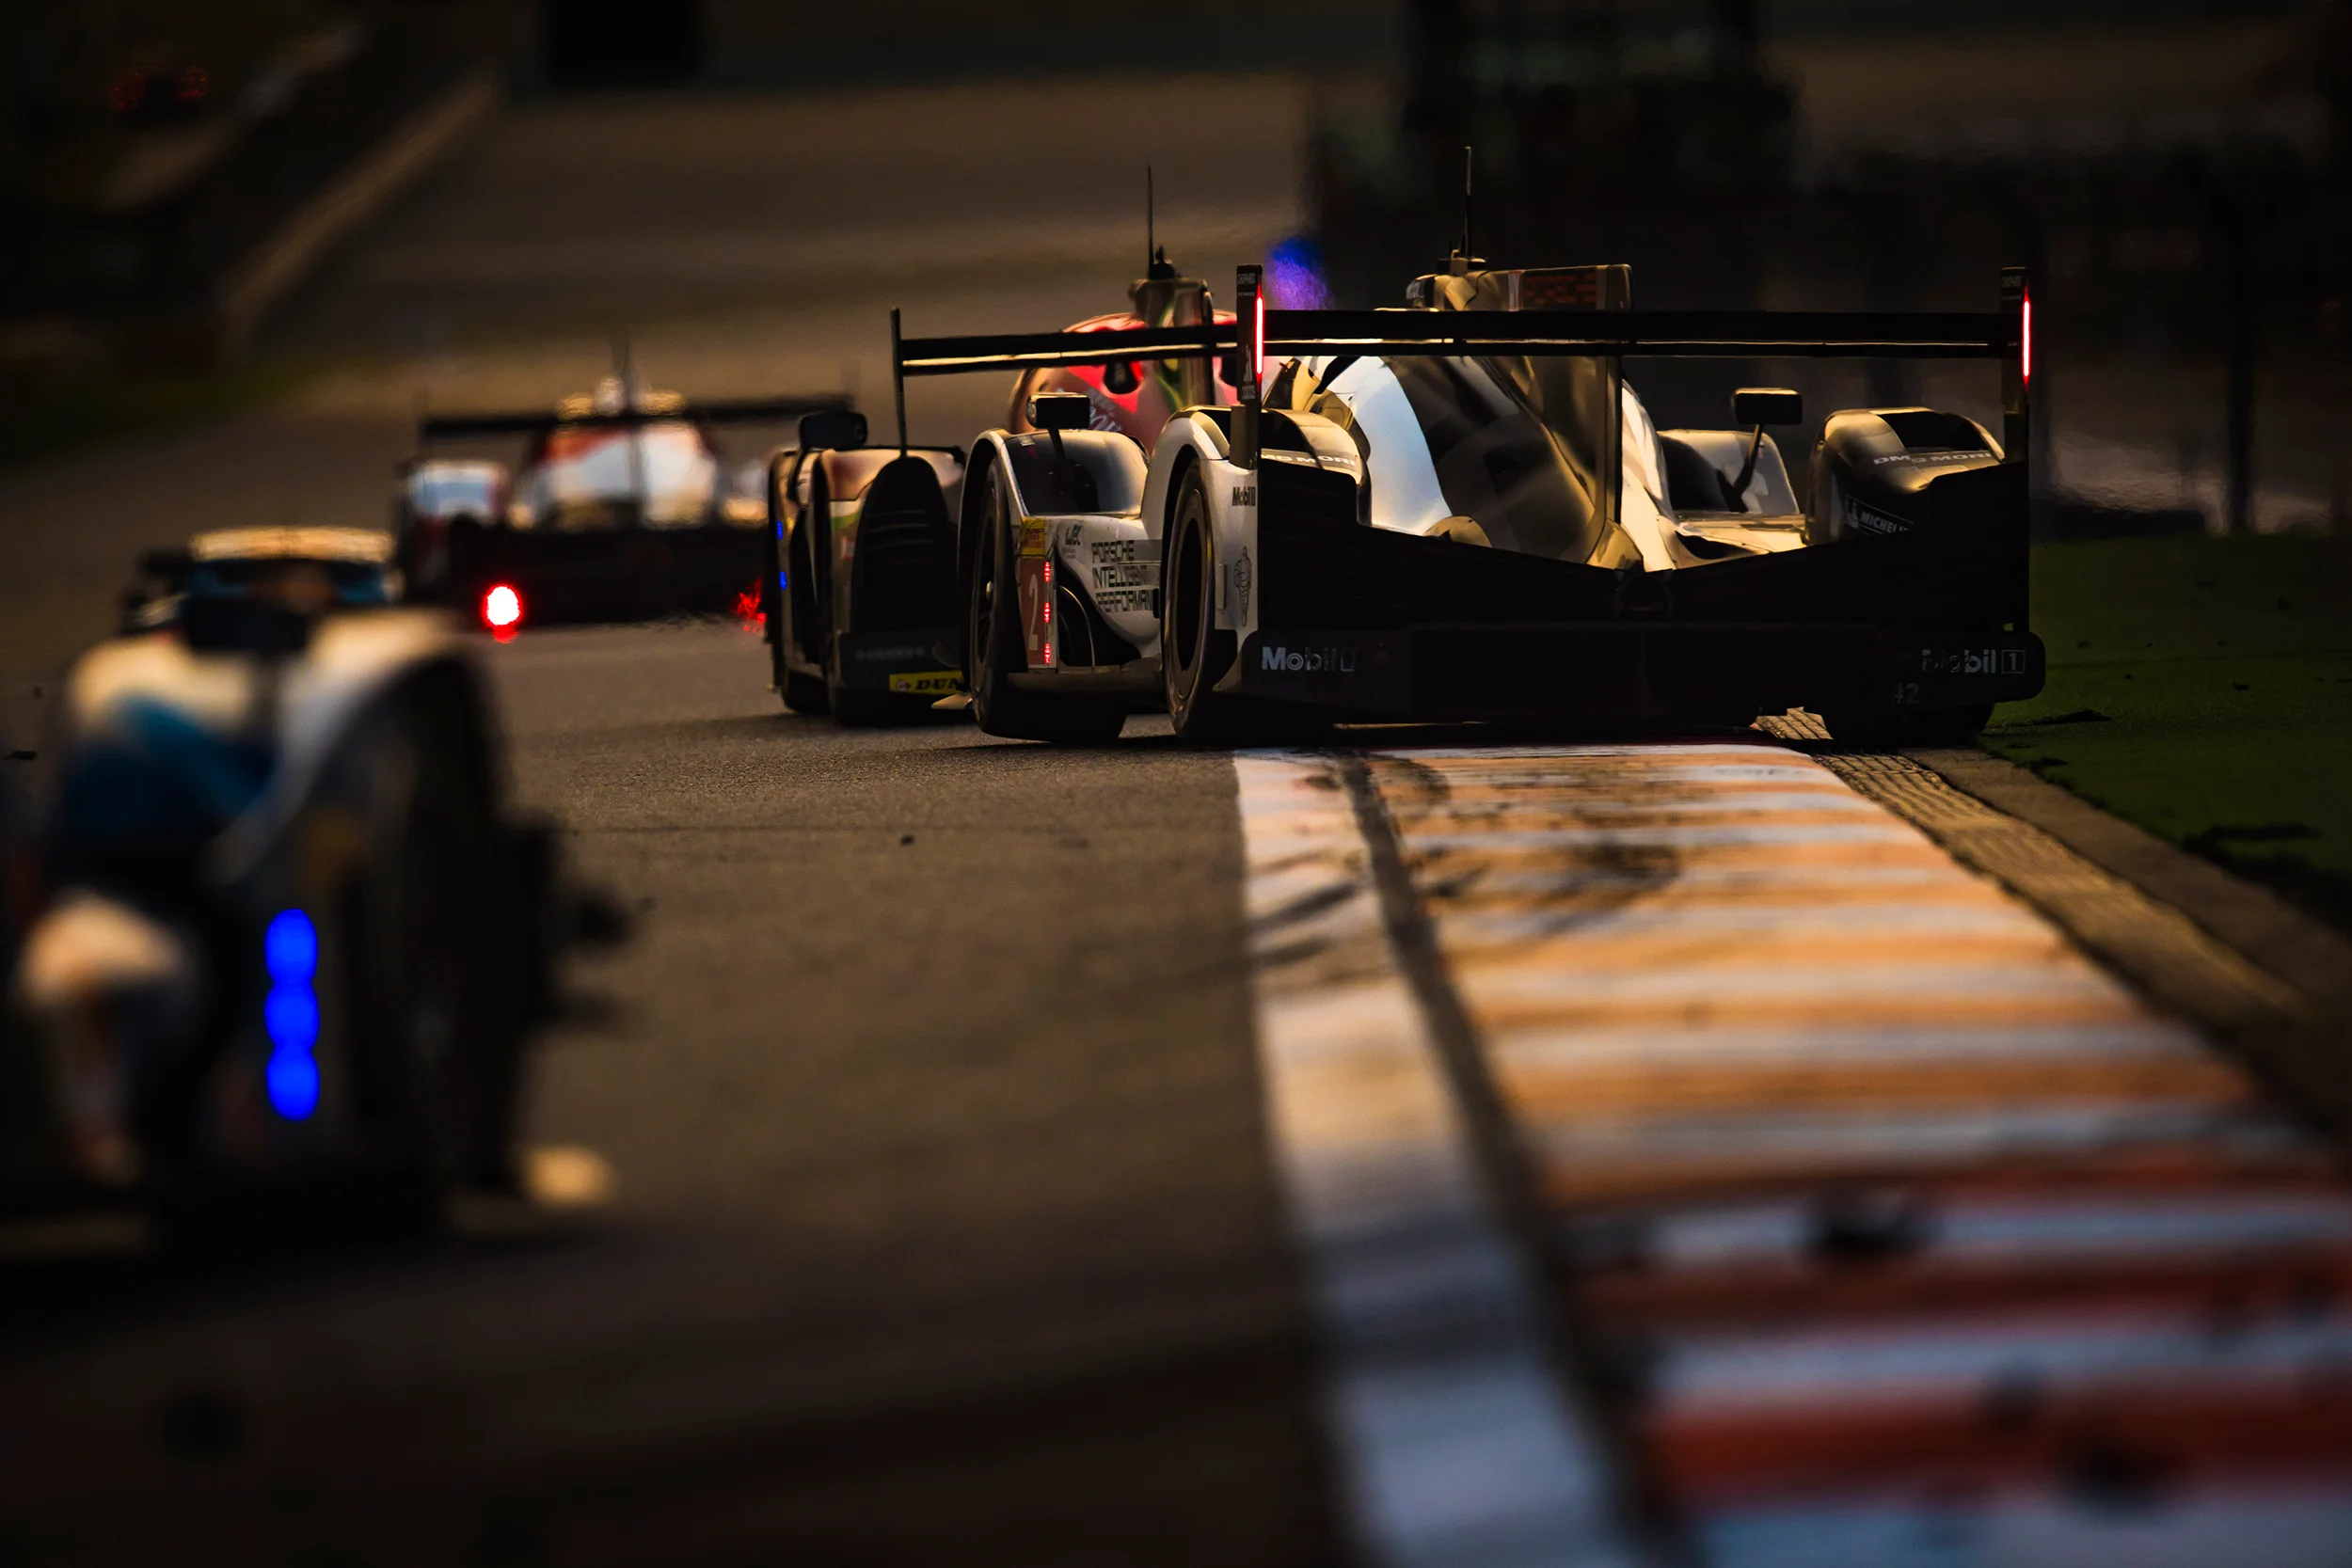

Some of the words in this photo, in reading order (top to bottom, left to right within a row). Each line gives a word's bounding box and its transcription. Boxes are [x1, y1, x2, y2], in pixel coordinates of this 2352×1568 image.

[1930, 452, 1992, 462] MORI
[1859, 510, 1909, 534] MICHEL
[1091, 540, 1135, 563] PORSCHE
[1028, 574, 1039, 651] 2
[1262, 646, 1338, 672] Mobil
[1922, 648, 1997, 673] Mobil
